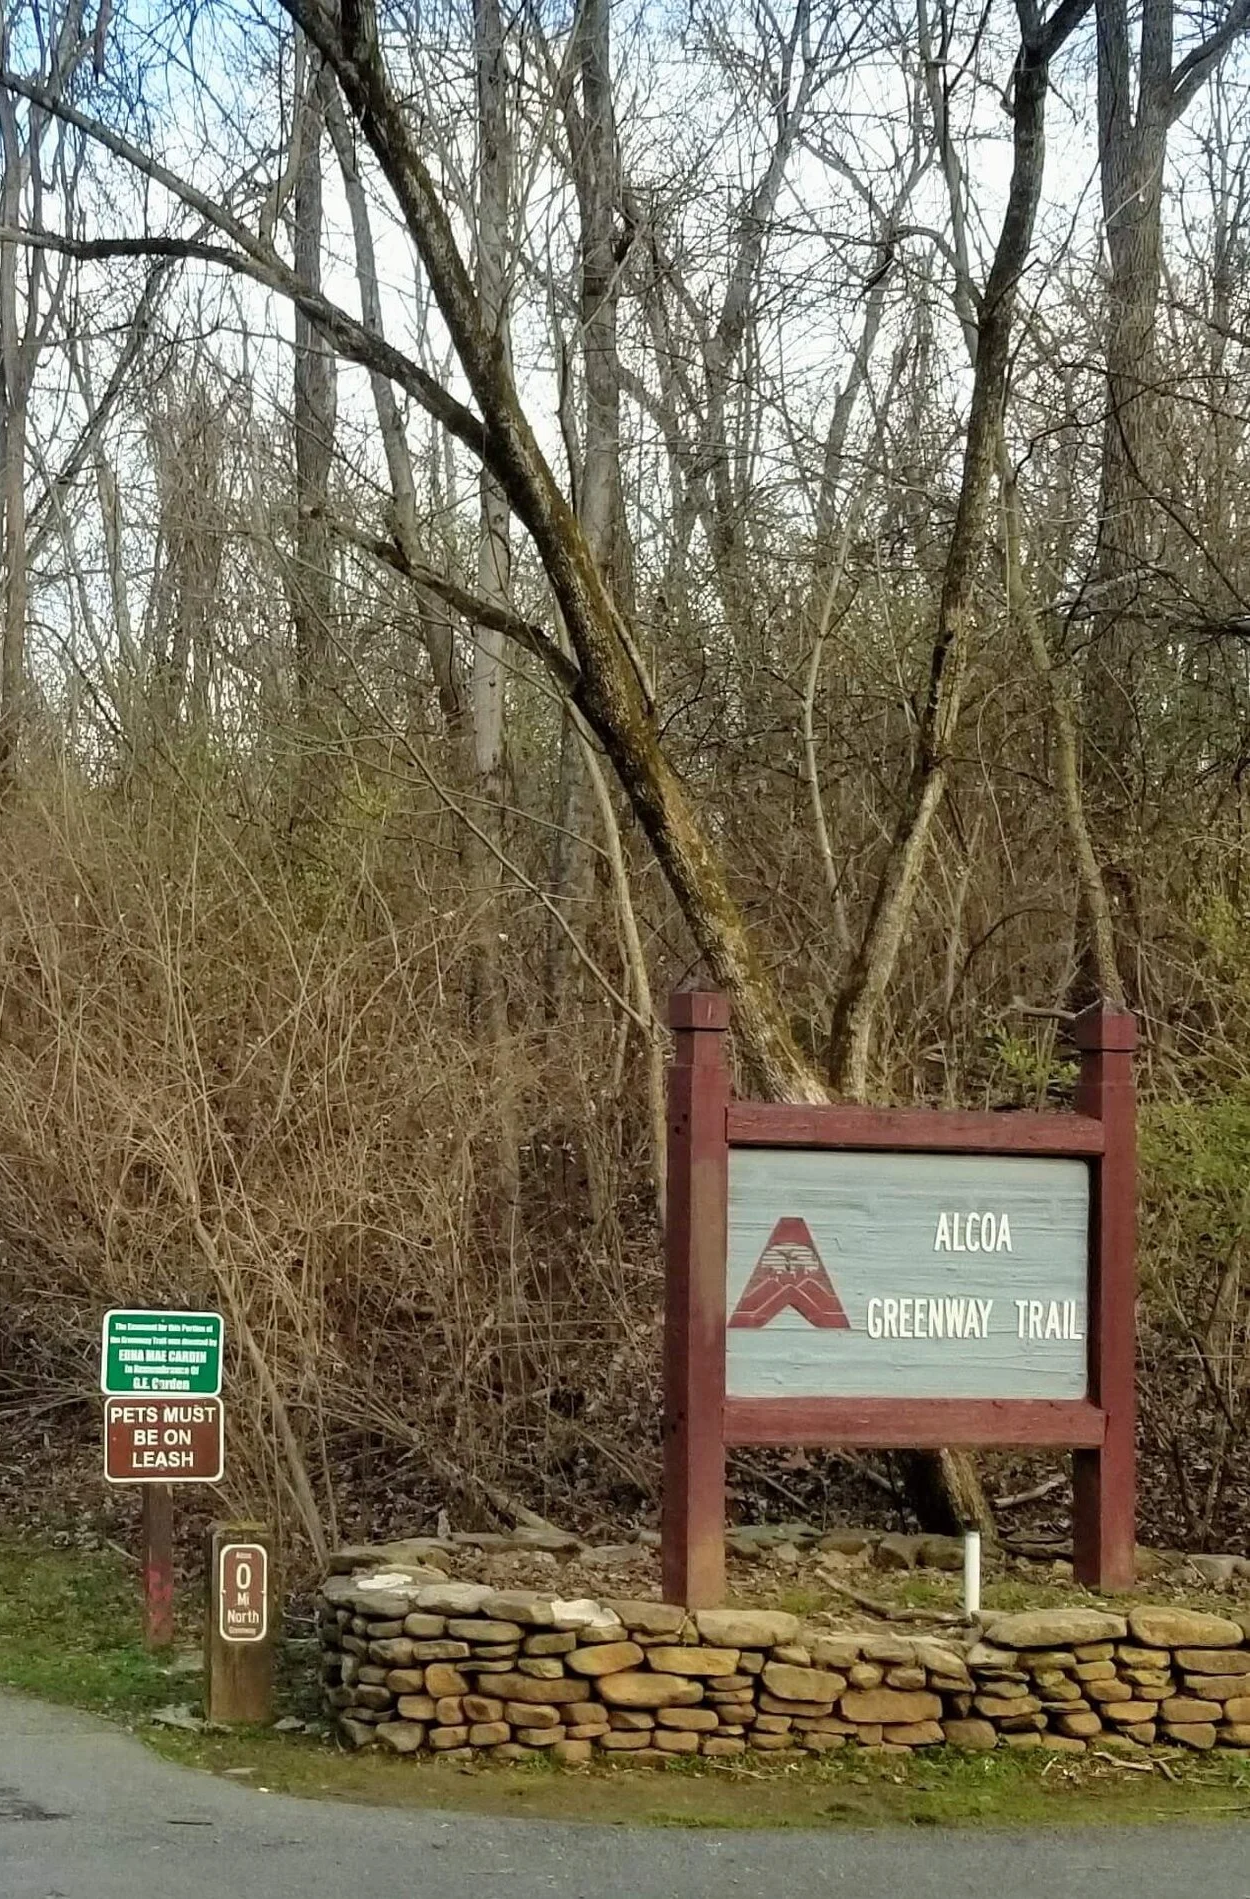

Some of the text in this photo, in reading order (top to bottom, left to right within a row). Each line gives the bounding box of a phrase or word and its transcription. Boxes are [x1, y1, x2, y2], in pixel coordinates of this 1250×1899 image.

[933, 1212, 1012, 1252] ALCOA
[866, 1297, 1083, 1340] GREENWAY TRAIL
[145, 1350, 167, 1362] MAE
[110, 1407, 216, 1423] PETS MUST
[134, 1429, 191, 1446] BE ON
[132, 1451, 194, 1468] LEASH
[236, 1563, 251, 1589] 0
[237, 1592, 250, 1606] Mi
[227, 1609, 260, 1623] North
